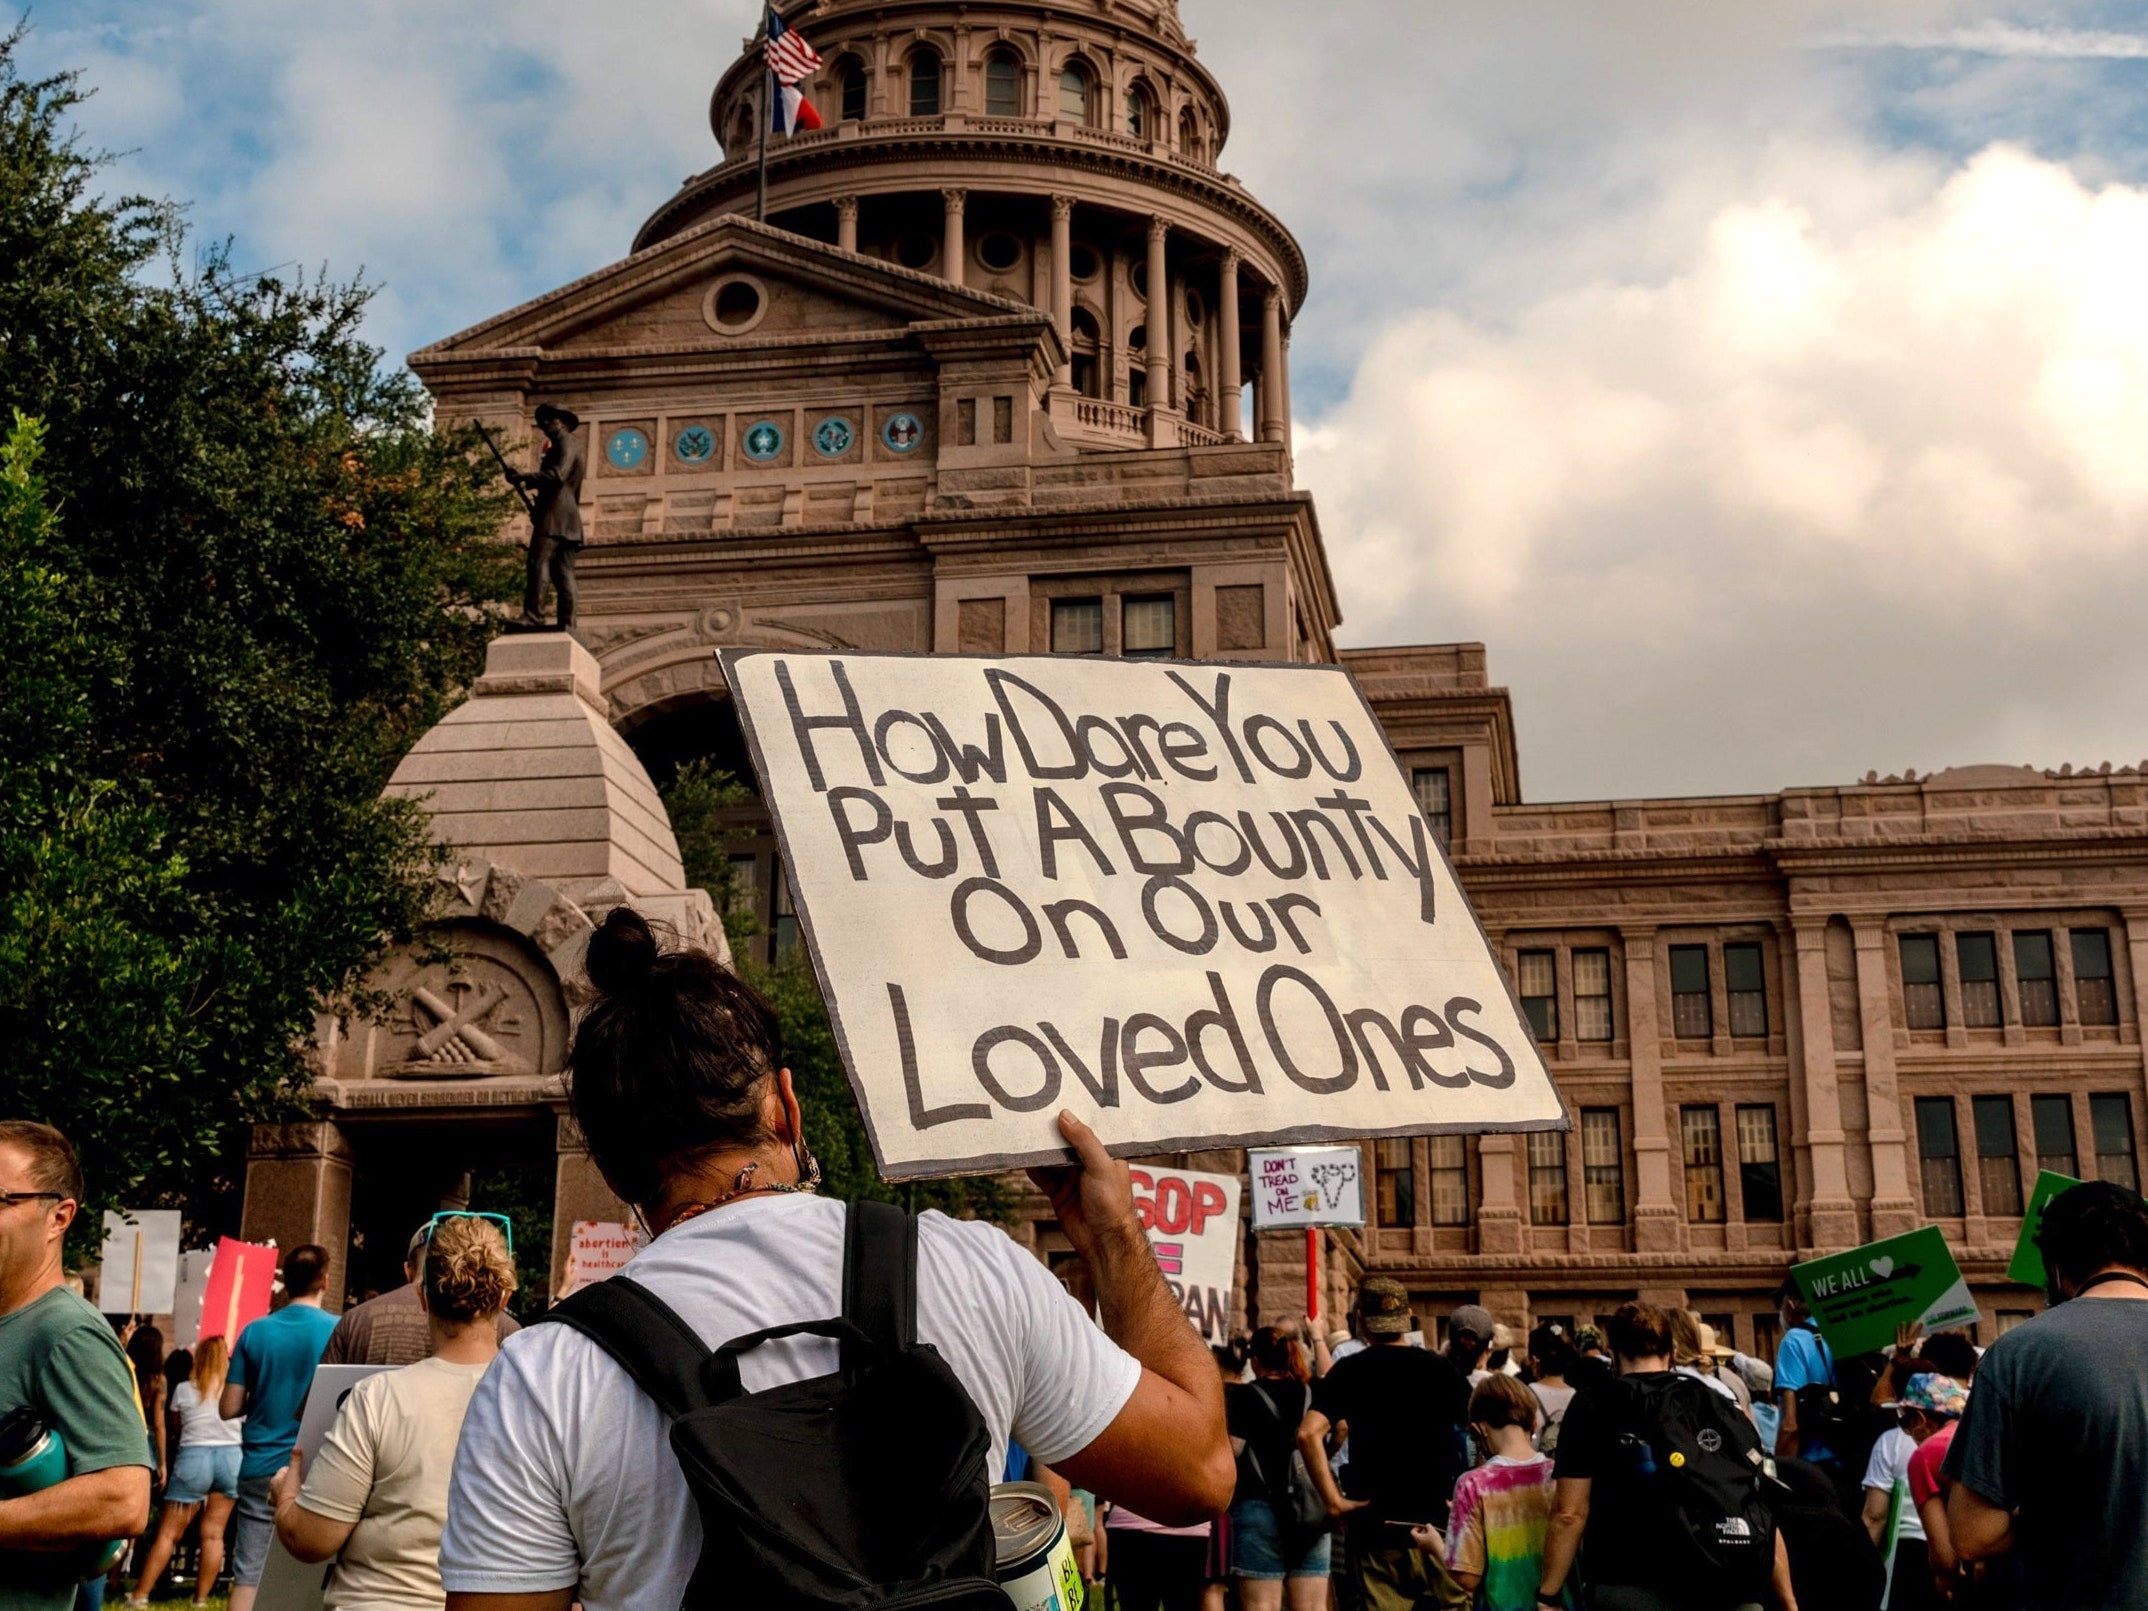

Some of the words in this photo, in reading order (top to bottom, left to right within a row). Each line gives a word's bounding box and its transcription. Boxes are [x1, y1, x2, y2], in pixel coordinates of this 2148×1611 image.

[774, 660, 1006, 792] How
[984, 668, 1218, 782] Dare
[1164, 670, 1362, 785] You
[826, 786, 1001, 881] Put
[1033, 787, 1117, 880] A
[1099, 781, 1435, 925] Bounty
[951, 877, 1128, 966] On
[1141, 874, 1321, 955] Our
[886, 971, 1265, 1131] Loved
[1256, 964, 1516, 1095] Ones
[1263, 1158, 1296, 1173] DON'T
[1258, 1174, 1299, 1188] TREAD
[1276, 1187, 1289, 1196] ON
[1267, 1195, 1299, 1215] ME
[580, 1239, 629, 1249] abortion
[602, 1250, 609, 1259] is
[1811, 1274, 1838, 1298] WE
[1842, 1267, 1870, 1290] ALL
